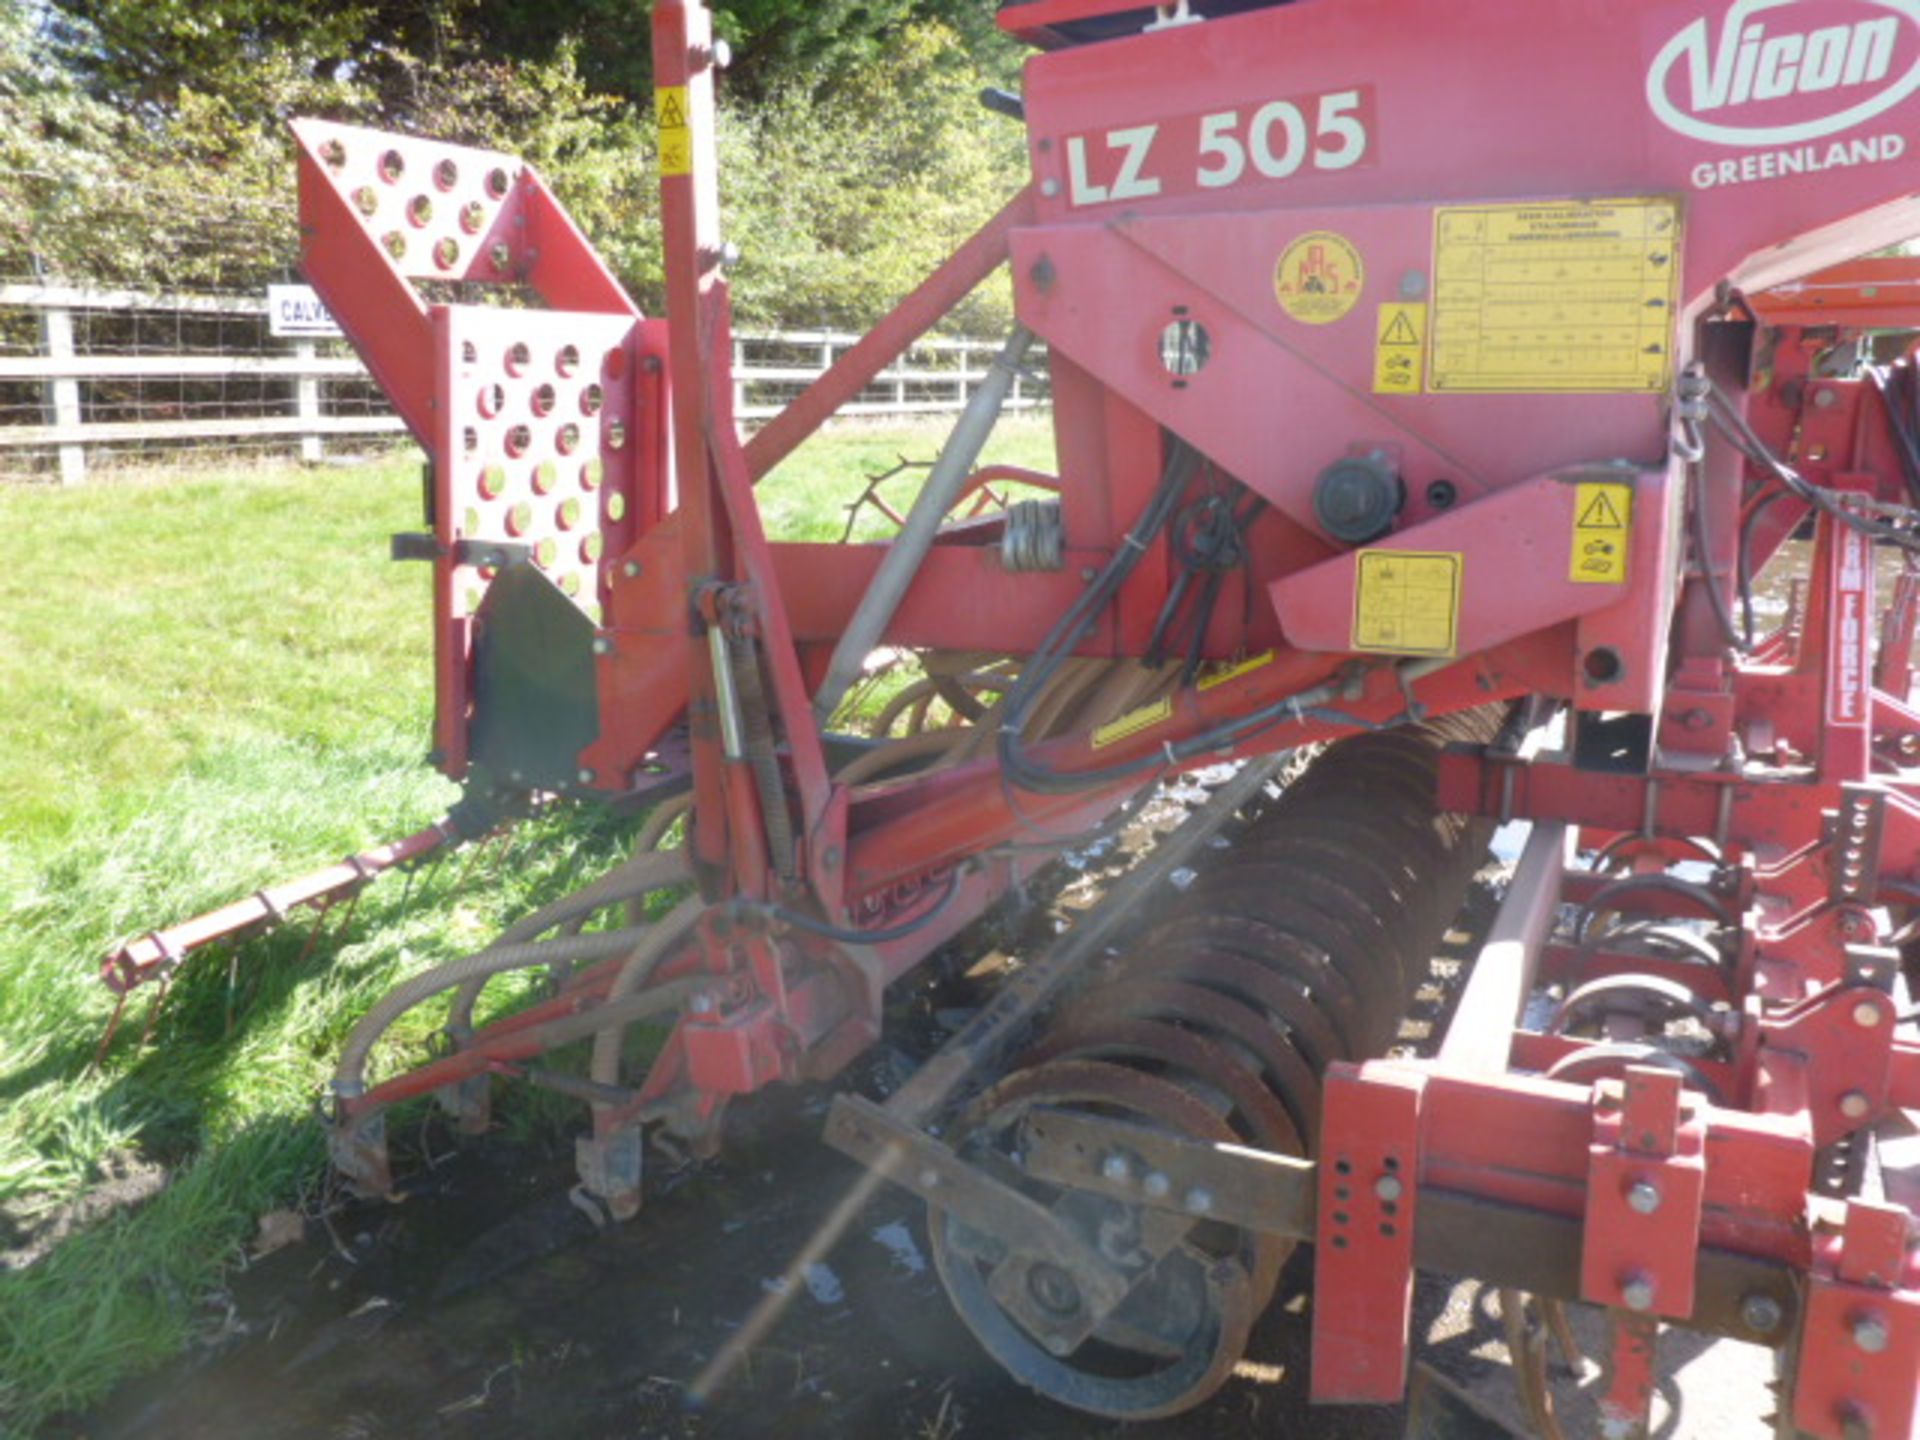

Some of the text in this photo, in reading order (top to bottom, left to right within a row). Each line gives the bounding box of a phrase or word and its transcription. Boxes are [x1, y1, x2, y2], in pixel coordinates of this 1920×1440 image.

[1686, 14, 1900, 112] Vicon
[1067, 91, 1368, 206] LZ 505
[1690, 134, 1906, 189] GREENLAND
[1840, 506, 1863, 591] ARM
